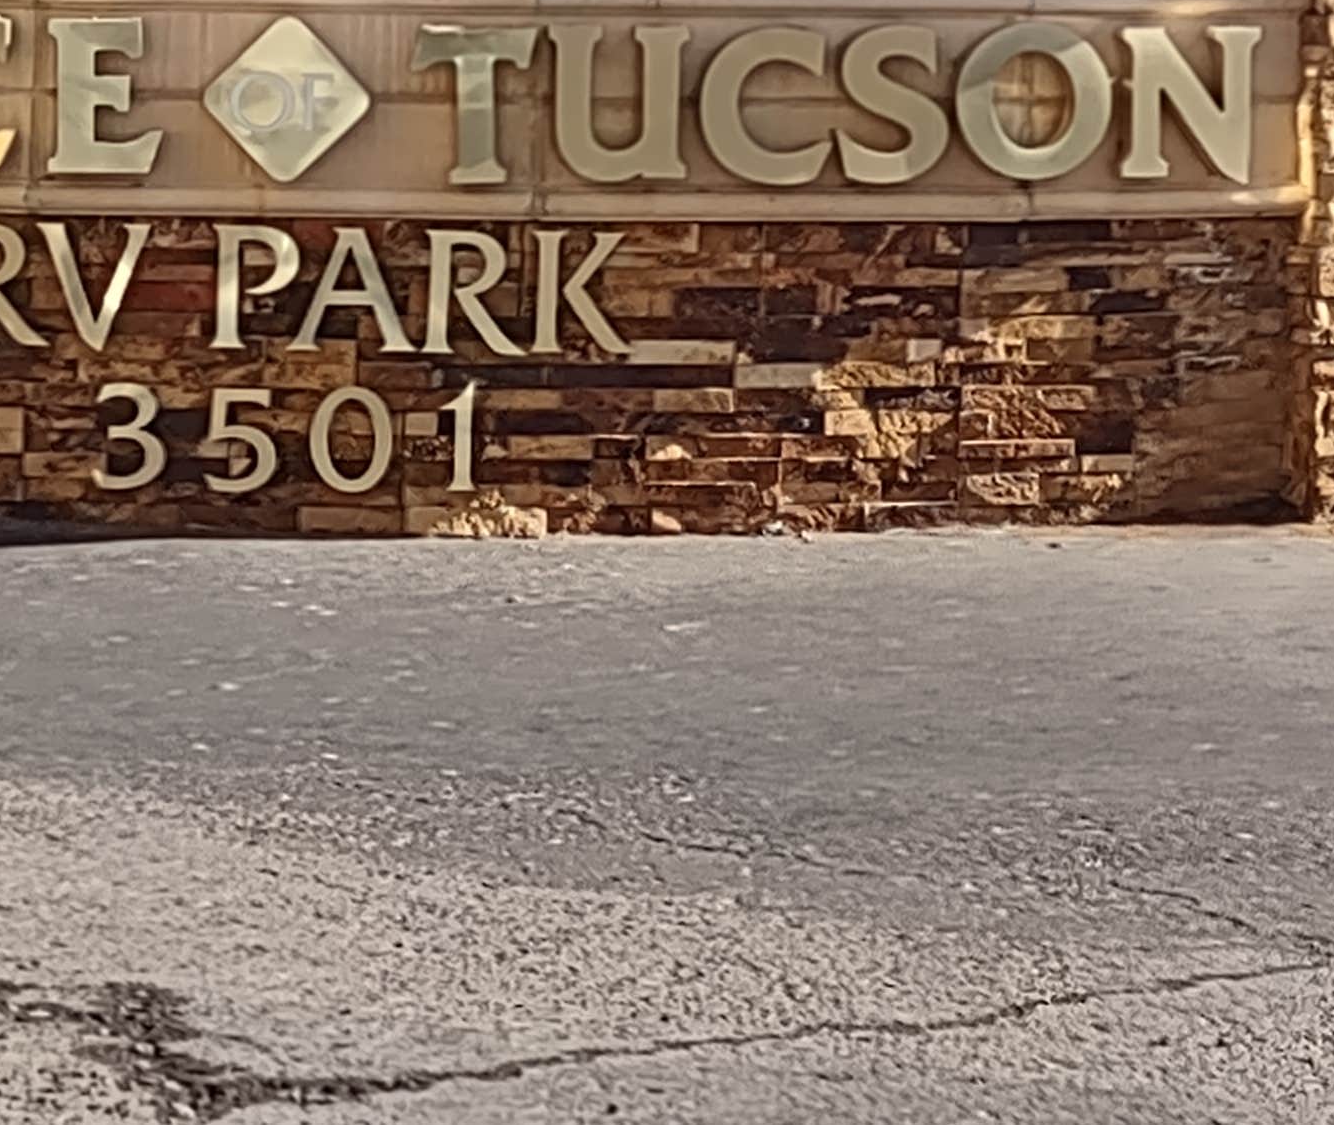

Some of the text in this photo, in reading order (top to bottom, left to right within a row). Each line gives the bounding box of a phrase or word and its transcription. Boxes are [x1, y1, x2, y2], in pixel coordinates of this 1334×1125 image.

[230, 69, 339, 136] OF
[413, 24, 1262, 185] TUCSON
[211, 225, 637, 357] PARK
[92, 377, 476, 494] 3501
